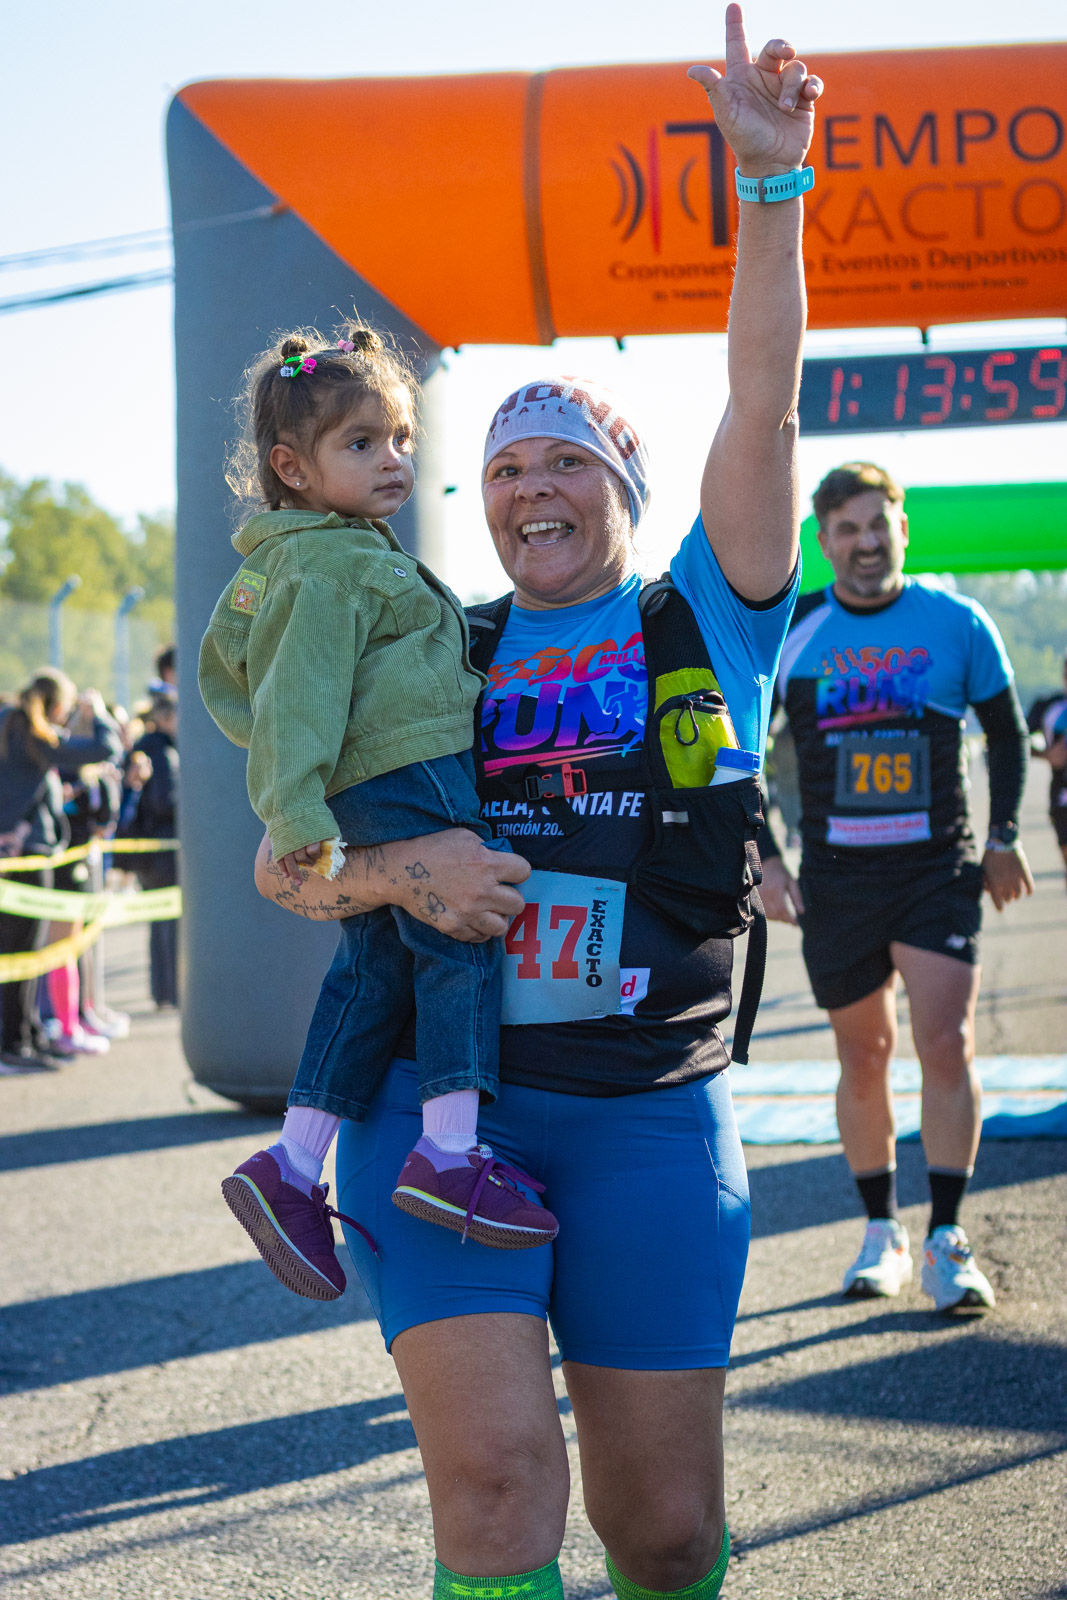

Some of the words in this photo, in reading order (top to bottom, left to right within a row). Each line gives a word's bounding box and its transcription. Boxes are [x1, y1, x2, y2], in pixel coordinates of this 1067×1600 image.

[803, 106, 1066, 172] EMPO
[803, 176, 1067, 246] XACTO
[608, 258, 734, 282] Cronomet
[821, 251, 921, 275] Eventos
[927, 245, 1067, 271] Deportivos
[852, 753, 913, 794] 765
[480, 798, 534, 819] AELA,
[618, 792, 645, 817] FE
[496, 820, 540, 836] EDICIÓN
[505, 902, 588, 980] 47
[585, 899, 608, 988] EXACTO
[620, 974, 637, 998] d
